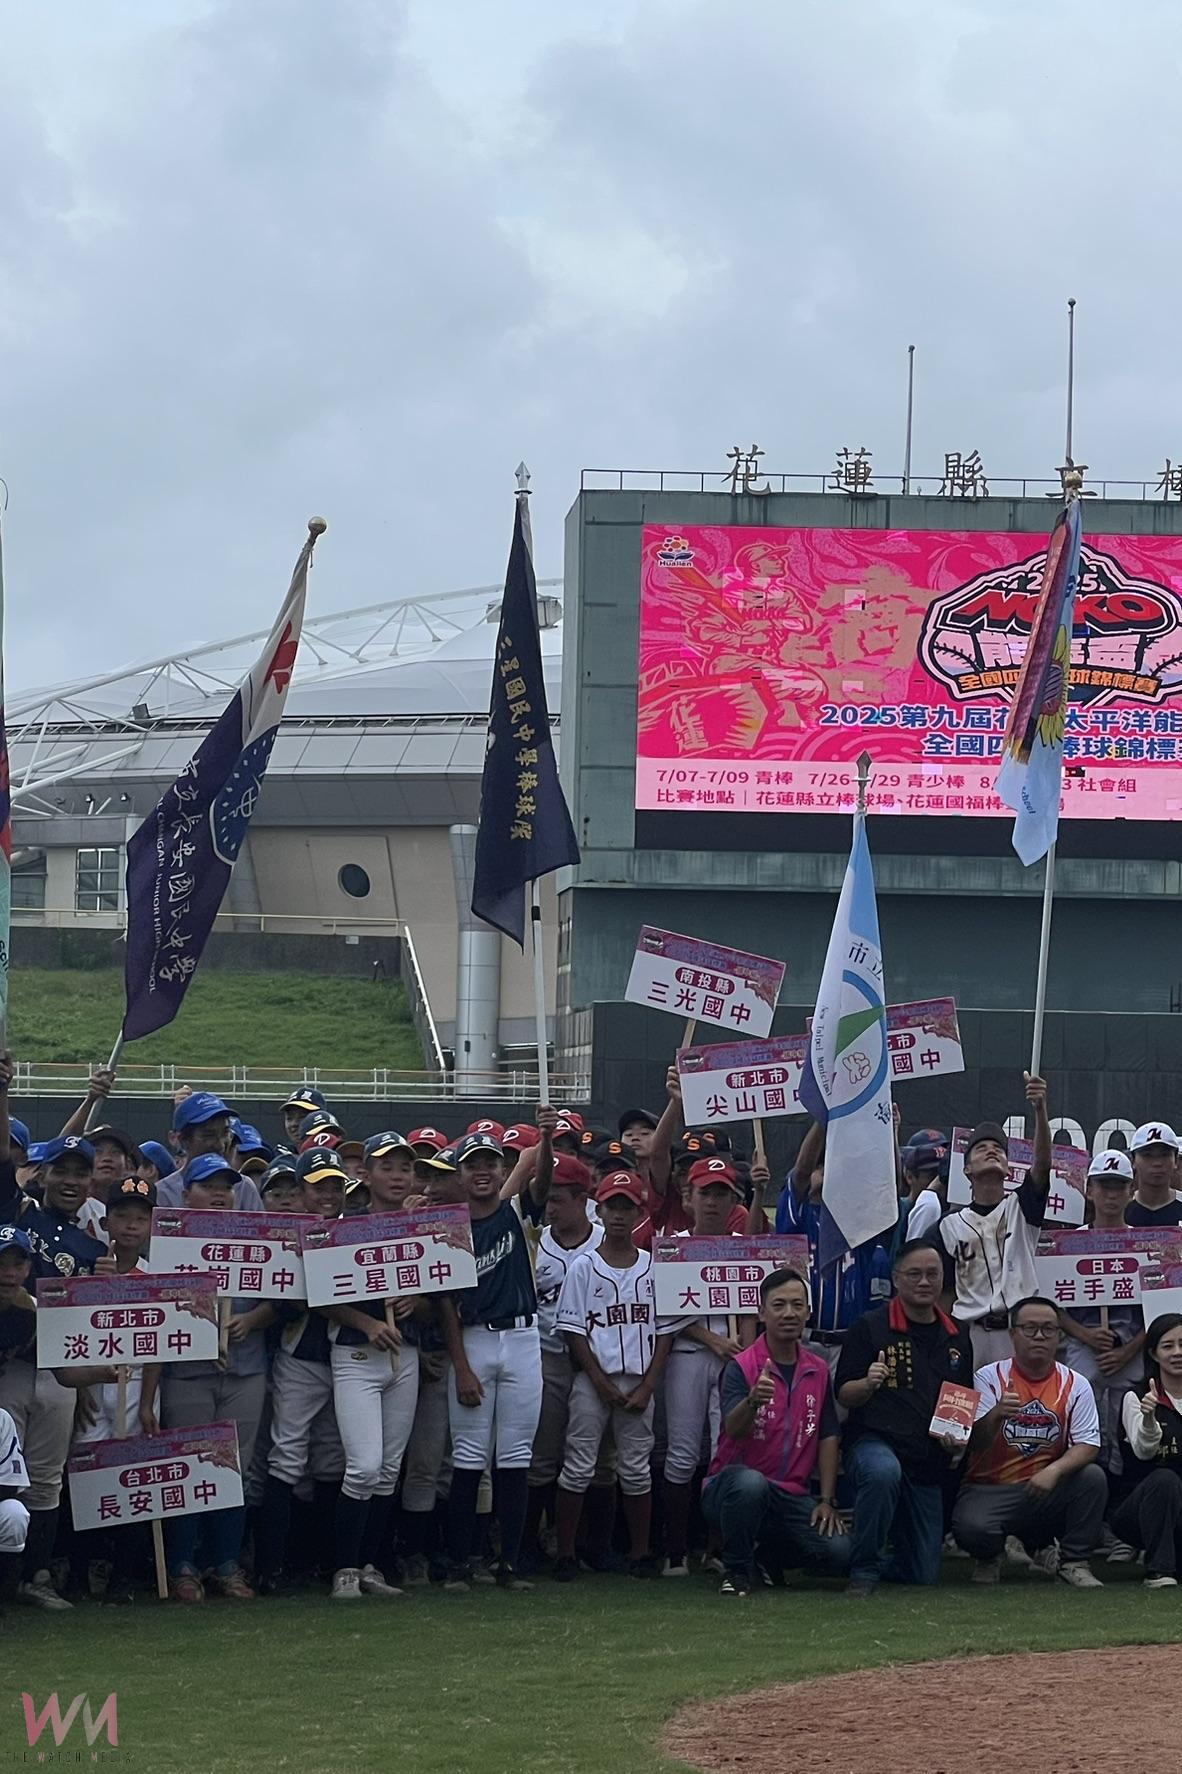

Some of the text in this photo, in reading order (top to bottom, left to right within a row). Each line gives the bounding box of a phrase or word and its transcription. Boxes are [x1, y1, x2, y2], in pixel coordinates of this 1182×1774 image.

[959, 669, 1160, 695] 全國四球錦標賽
[656, 770, 750, 785] 7/07-7/09
[755, 771, 794, 786] 青棒
[808, 772, 900, 788] 7/26-/29
[907, 774, 965, 789] 青少棒
[1077, 777, 1137, 793] 社會組
[656, 788, 735, 805] 比賽地點
[680, 968, 732, 995] 南投縣
[647, 981, 752, 1026] 三光國中
[730, 1068, 785, 1088] 新北市
[705, 1088, 801, 1118] 尖山國
[206, 1243, 266, 1262] 花蓮縣
[360, 1242, 420, 1265] 宜蘭縣
[705, 1266, 764, 1282] 桃園市
[1091, 1258, 1125, 1274] 日本
[332, 1260, 452, 1297] 三星國中
[1054, 1278, 1135, 1301] 岩手盛
[679, 1286, 761, 1309] 大園國
[96, 1309, 161, 1328] 新北市
[63, 1329, 192, 1360] 淡水國中
[126, 1463, 184, 1486] 台北市
[97, 1479, 217, 1521] 長安國中
